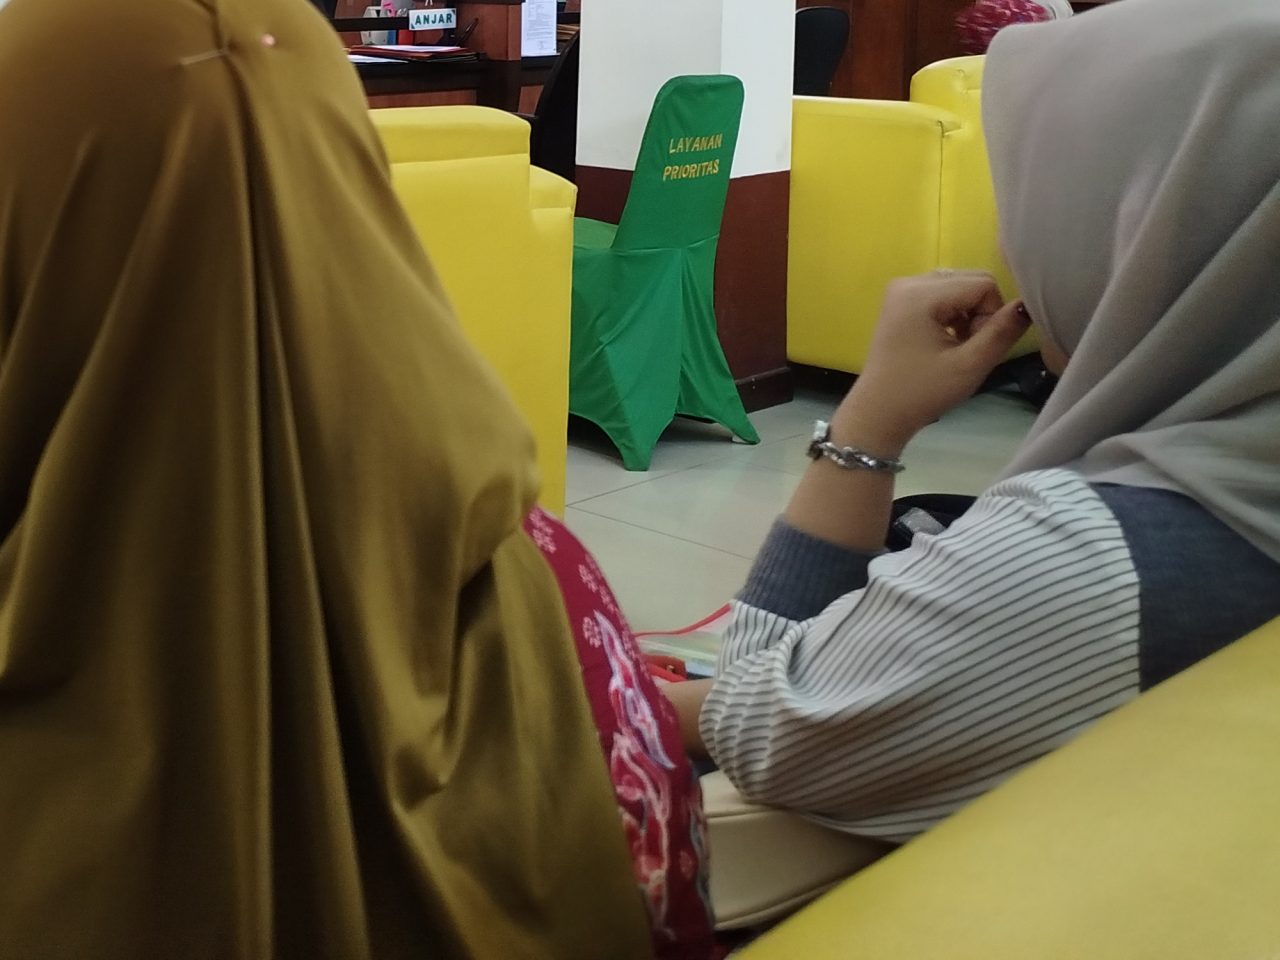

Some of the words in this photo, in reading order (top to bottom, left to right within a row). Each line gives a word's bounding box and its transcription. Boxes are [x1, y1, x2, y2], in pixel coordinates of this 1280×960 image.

[414, 13, 453, 26] ANJAR
[669, 133, 723, 154] LAYANAN
[662, 158, 720, 181] PRIORITAS
